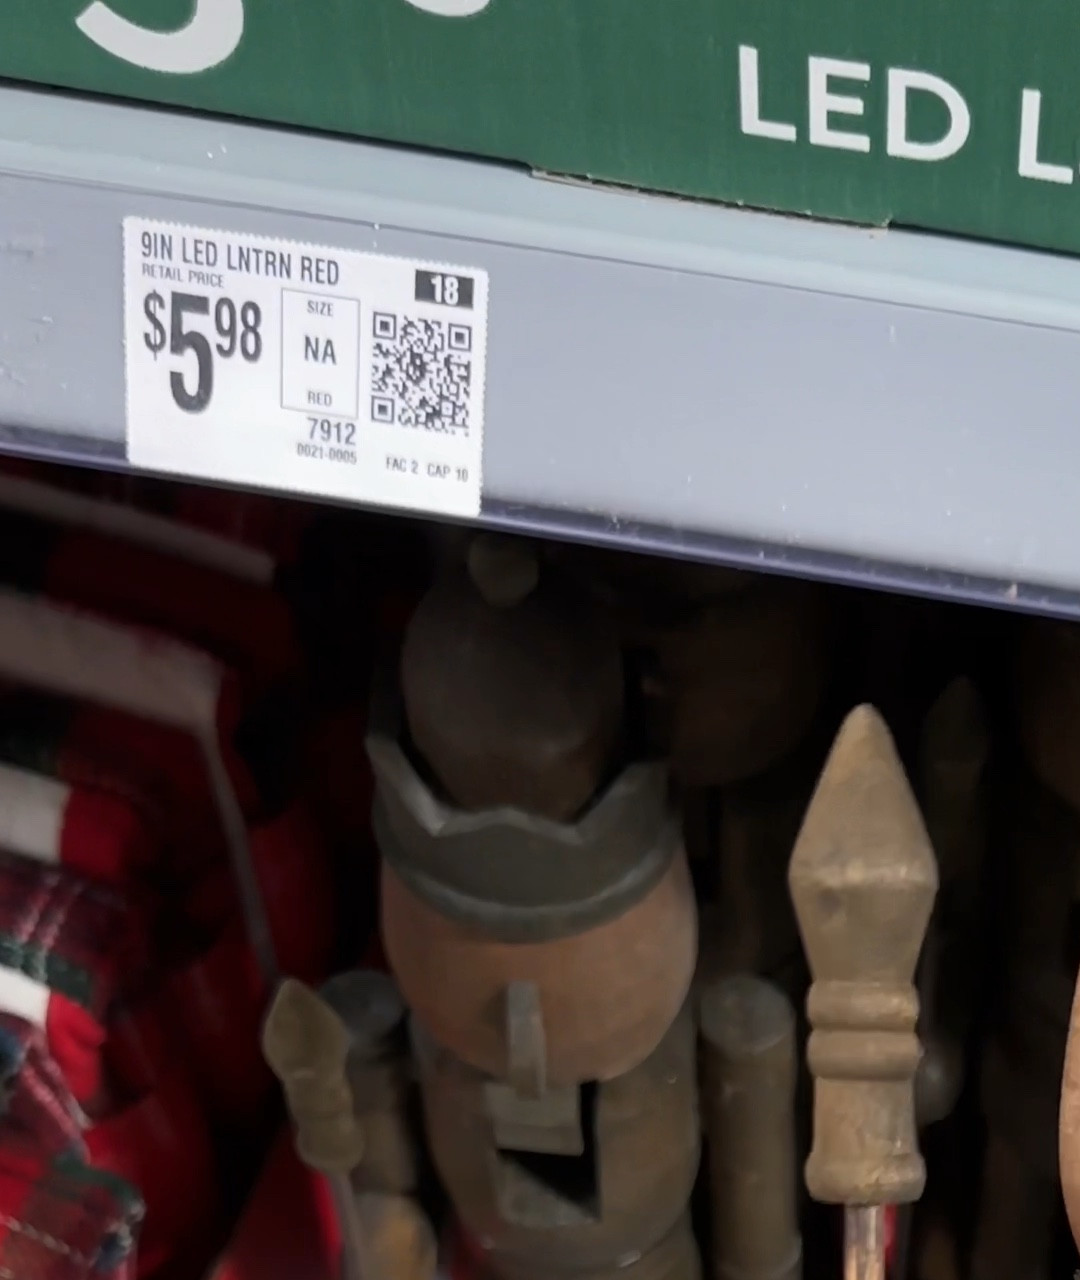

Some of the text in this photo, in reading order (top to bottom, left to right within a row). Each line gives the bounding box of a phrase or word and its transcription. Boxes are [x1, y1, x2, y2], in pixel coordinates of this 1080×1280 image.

[738, 45, 971, 162] LED
[141, 231, 339, 286] 9IN LED LNTRN RED
[142, 263, 224, 288] RETAIL PRICE
[431, 274, 459, 306] 18
[307, 300, 334, 317] SIZE
[304, 335, 337, 365] NA
[307, 390, 332, 407] RED
[307, 417, 357, 446] 7912
[297, 443, 358, 465] 0021-0005
[386, 456, 407, 474] FAC
[410, 460, 419, 475] 2
[427, 463, 451, 479] CAP
